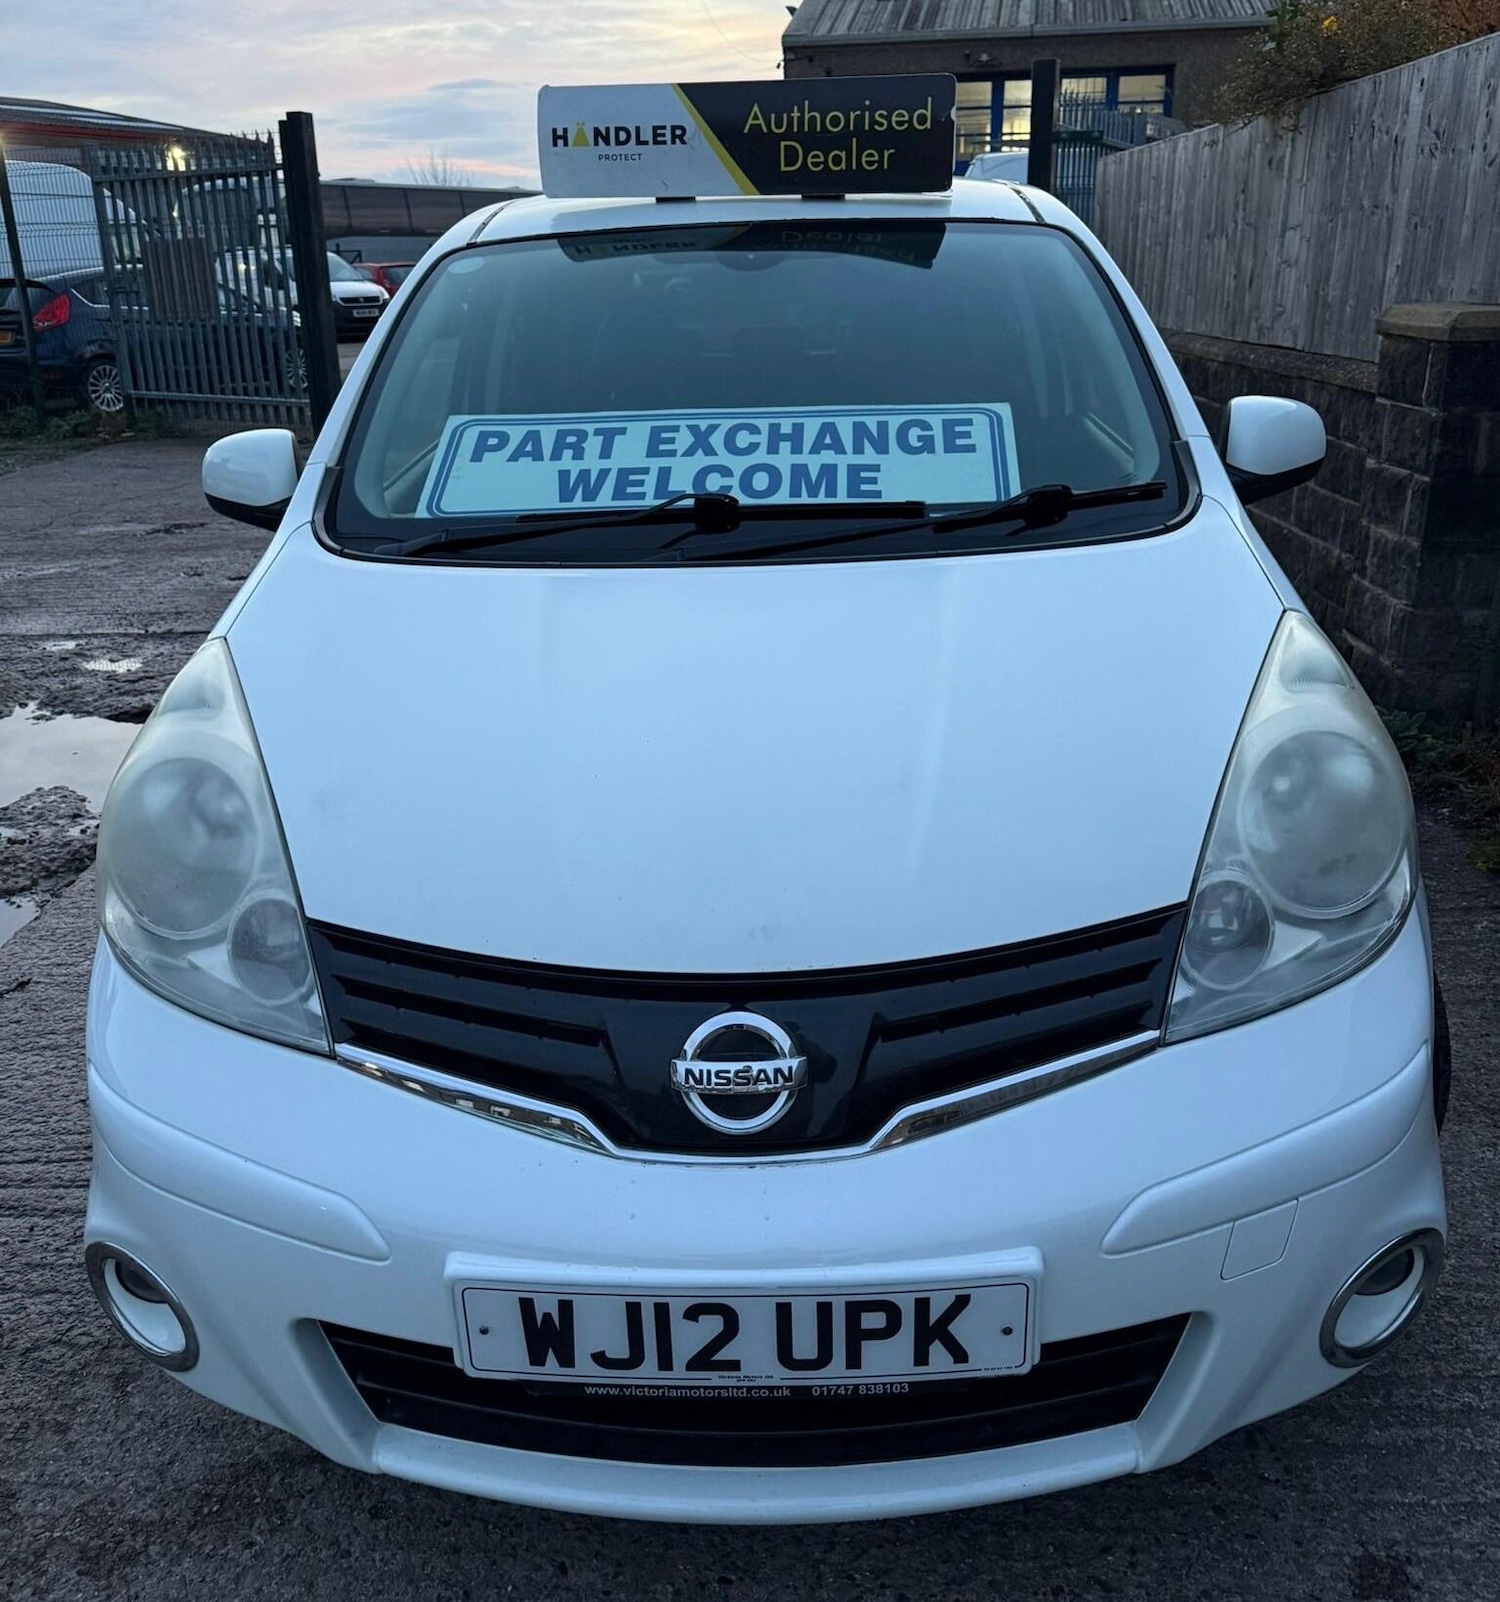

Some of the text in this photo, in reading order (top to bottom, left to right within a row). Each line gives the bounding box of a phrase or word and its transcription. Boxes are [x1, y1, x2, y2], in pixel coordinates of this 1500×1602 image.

[743, 96, 932, 134] Authorised
[598, 153, 643, 162] PROTECT
[780, 137, 896, 172] Dealer
[469, 418, 977, 463] PART EXCHANGE
[557, 463, 883, 503] WELCOME
[683, 1065, 794, 1087] NISSAN
[518, 1293, 972, 1372] WJ12 UPK
[584, 1383, 910, 1398] www.victoriamotorsltd.co.uk 01747 838103
